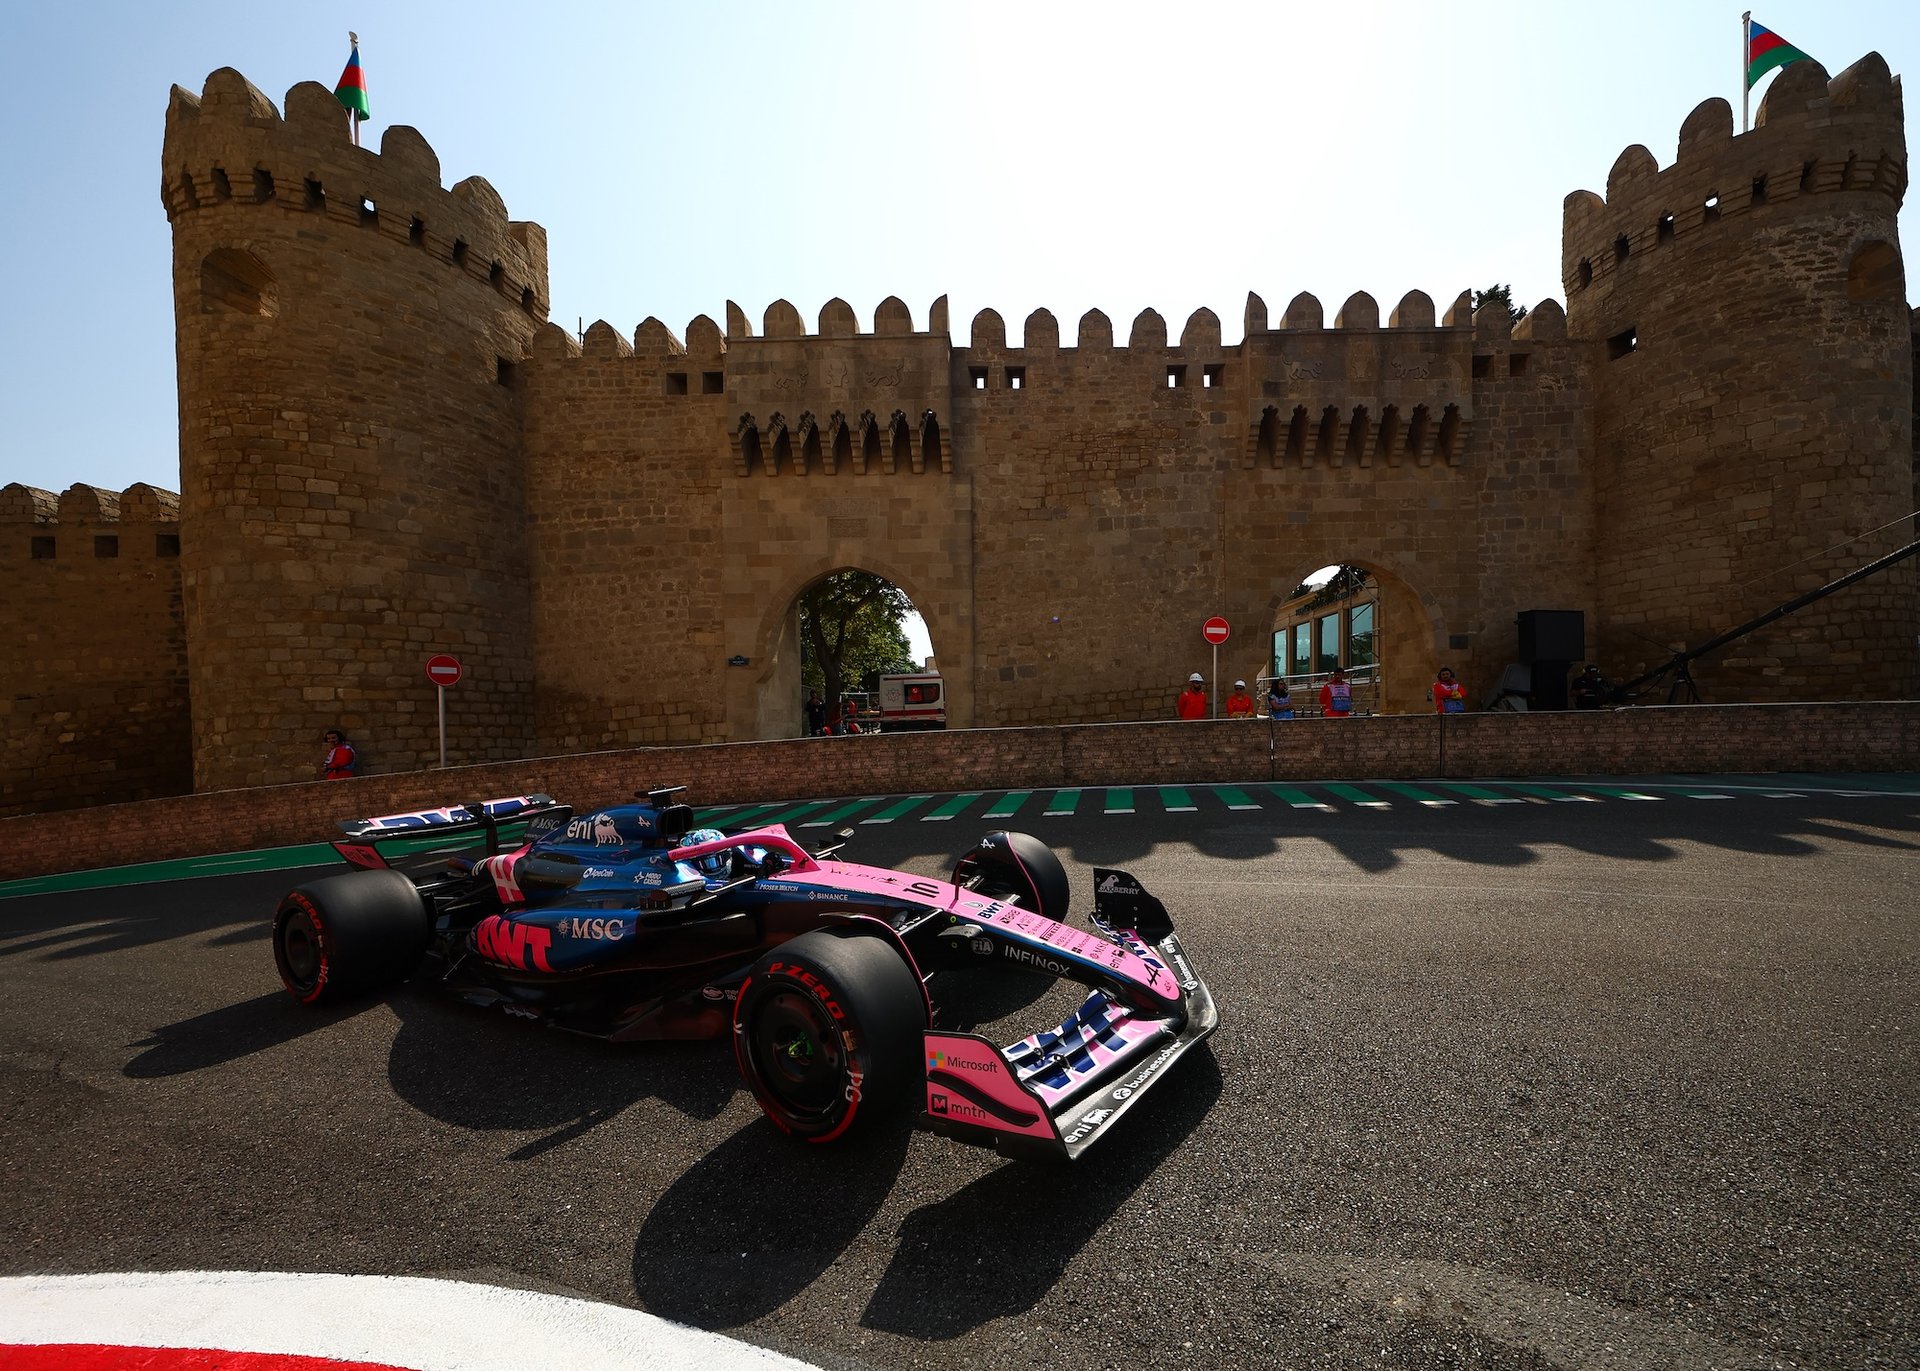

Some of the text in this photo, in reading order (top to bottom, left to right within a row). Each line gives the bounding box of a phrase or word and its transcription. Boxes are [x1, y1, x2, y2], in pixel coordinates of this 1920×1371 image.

[566, 815, 595, 840] eni
[816, 892, 849, 901] BINANCE
[977, 902, 1004, 919] BWT
[571, 917, 624, 941] MSC
[476, 914, 556, 974] BWT
[1004, 944, 1070, 977] INFINOX
[769, 962, 845, 1019] P ZERO
[947, 1056, 998, 1073] Microsoft
[1125, 1040, 1183, 1090] businessolver
[951, 1102, 986, 1119] mntn
[1064, 1118, 1091, 1143] eni
